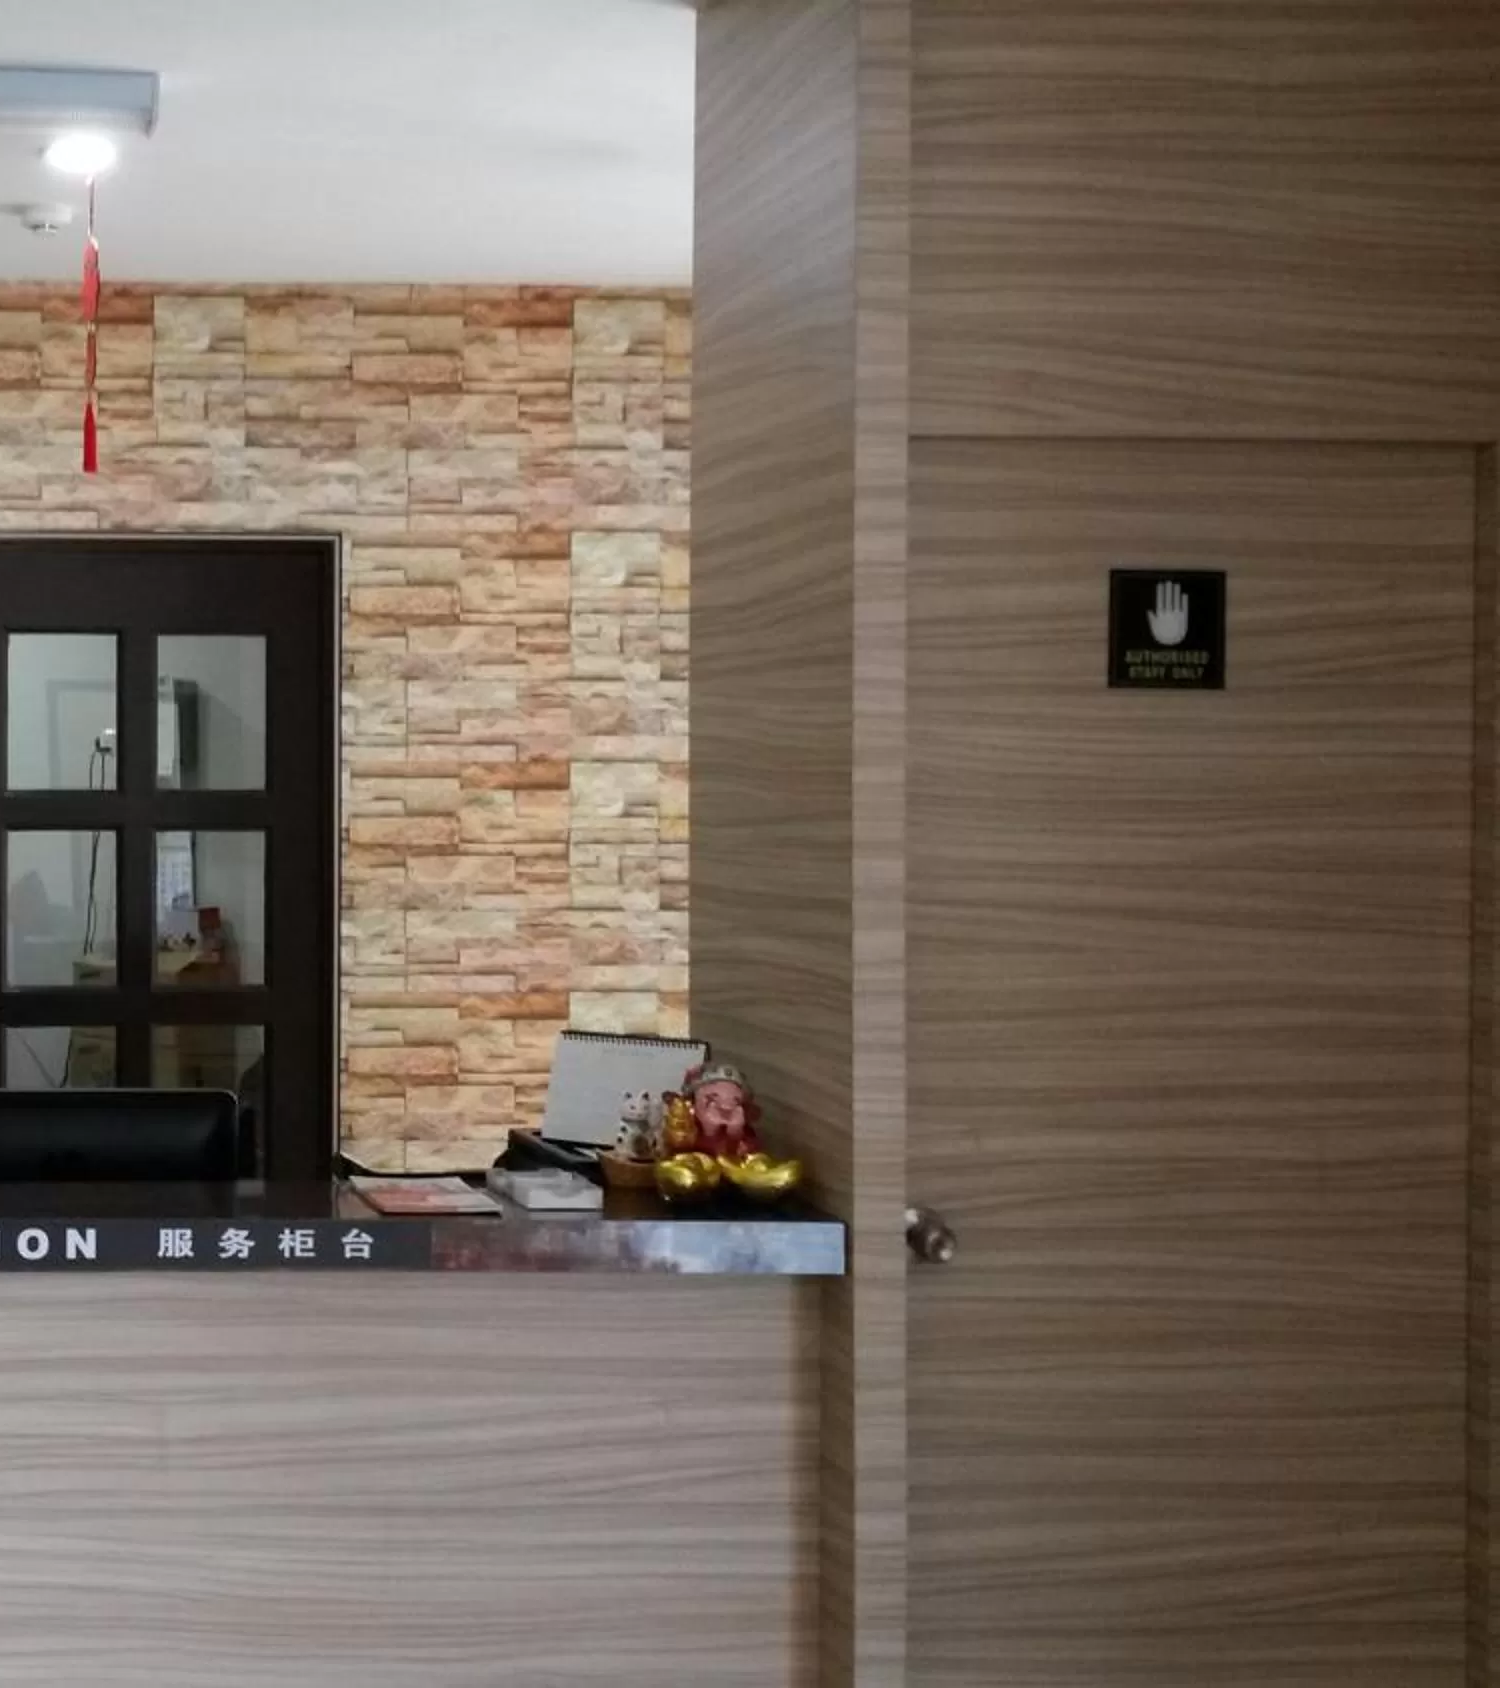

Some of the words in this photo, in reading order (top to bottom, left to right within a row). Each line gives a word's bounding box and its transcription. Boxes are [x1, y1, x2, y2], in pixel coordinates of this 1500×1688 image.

[1128, 666, 1166, 680] STAFF
[1171, 666, 1205, 680] ONLY
[156, 1228, 376, 1260] 服务柜台
